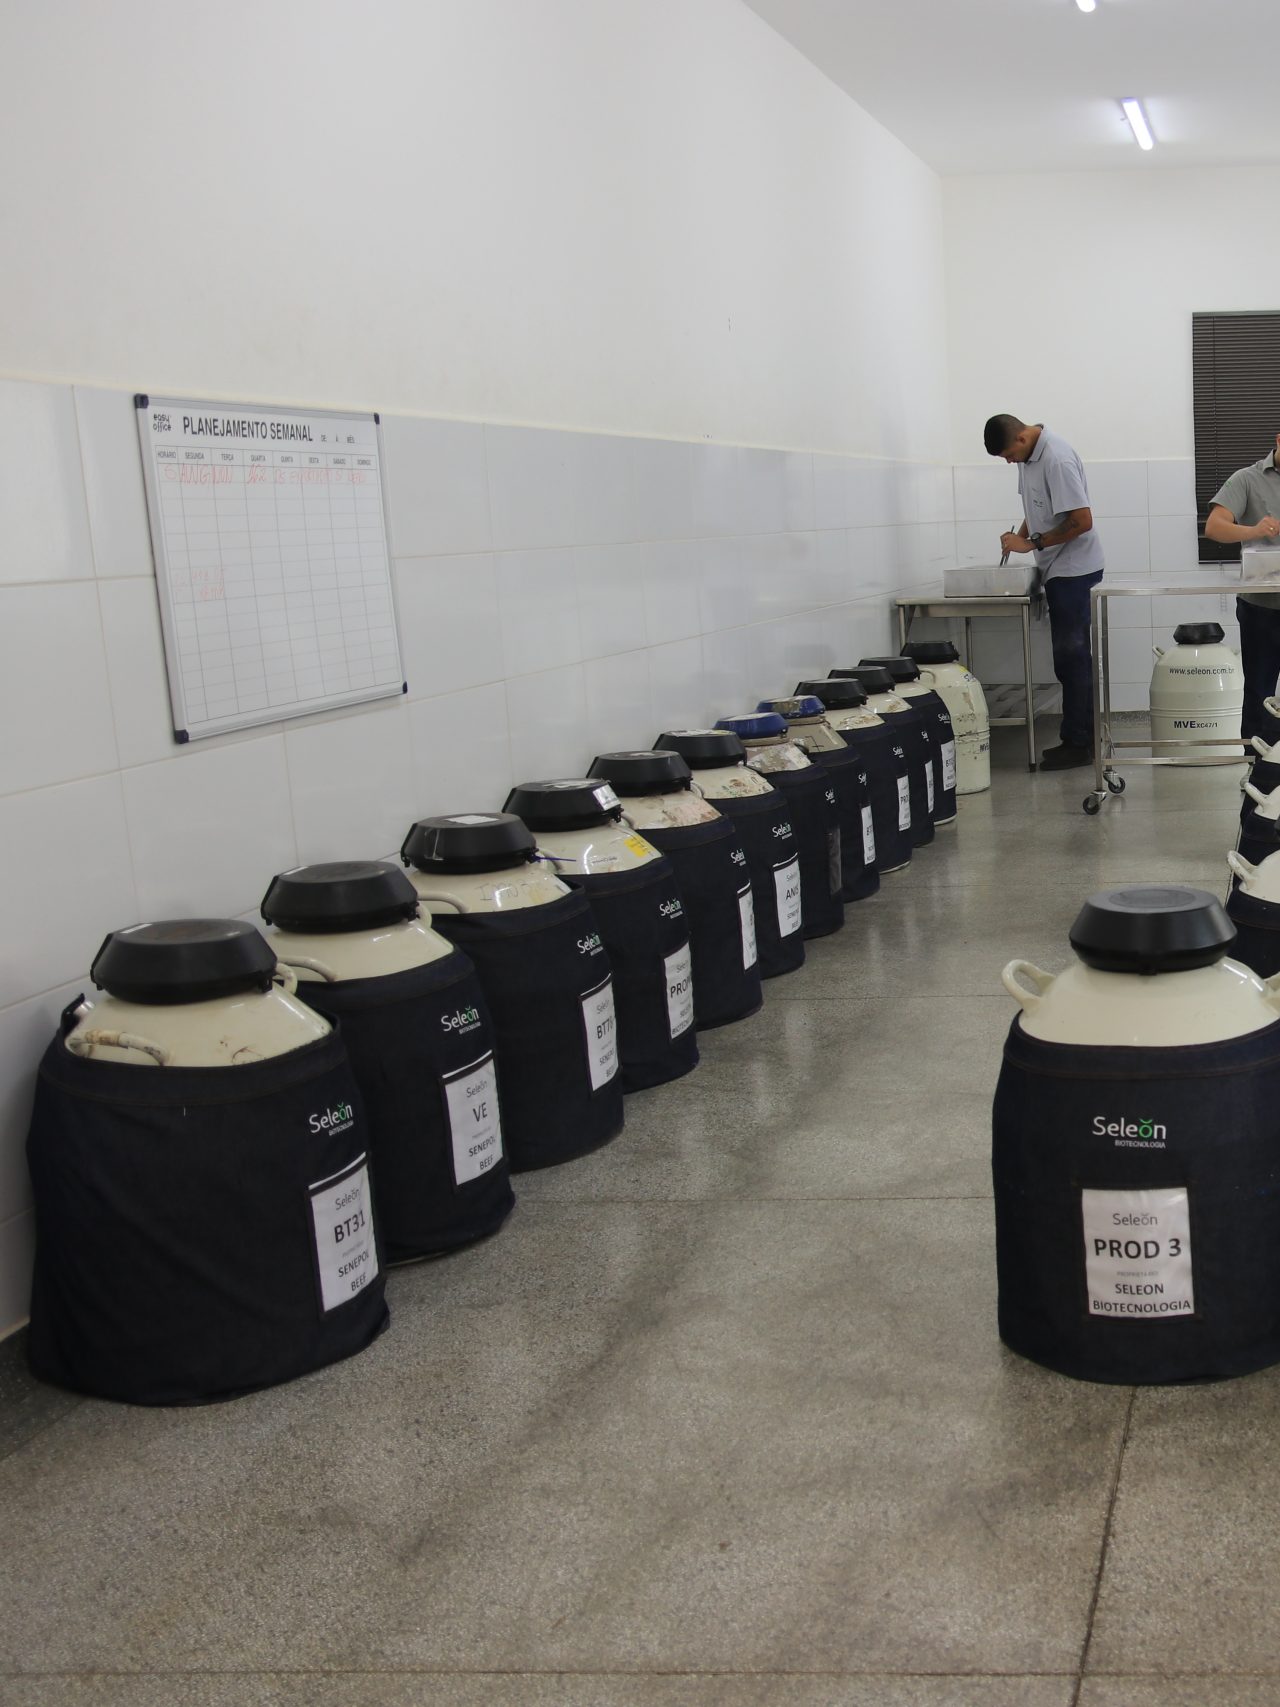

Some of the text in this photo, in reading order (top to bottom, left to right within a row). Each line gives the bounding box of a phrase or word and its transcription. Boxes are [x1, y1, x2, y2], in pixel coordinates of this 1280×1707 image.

[183, 416, 313, 441] PLANEJAMENTO SEMANAL
[1169, 665, 1235, 676] www.seleon.com.br
[1174, 720, 1196, 729] MVE
[472, 1102, 488, 1123] VE
[1114, 1139, 1166, 1149] BIOTECNOLOGIA
[479, 1153, 494, 1171] BEEF
[334, 1210, 366, 1244] BT31
[1094, 1238, 1182, 1259] PROD 3
[338, 1249, 370, 1279] SENEPOL
[351, 1271, 367, 1293] BEEF
[1115, 1283, 1164, 1296] SELEON
[1093, 1300, 1191, 1314] BIOTECNOLOGIA
